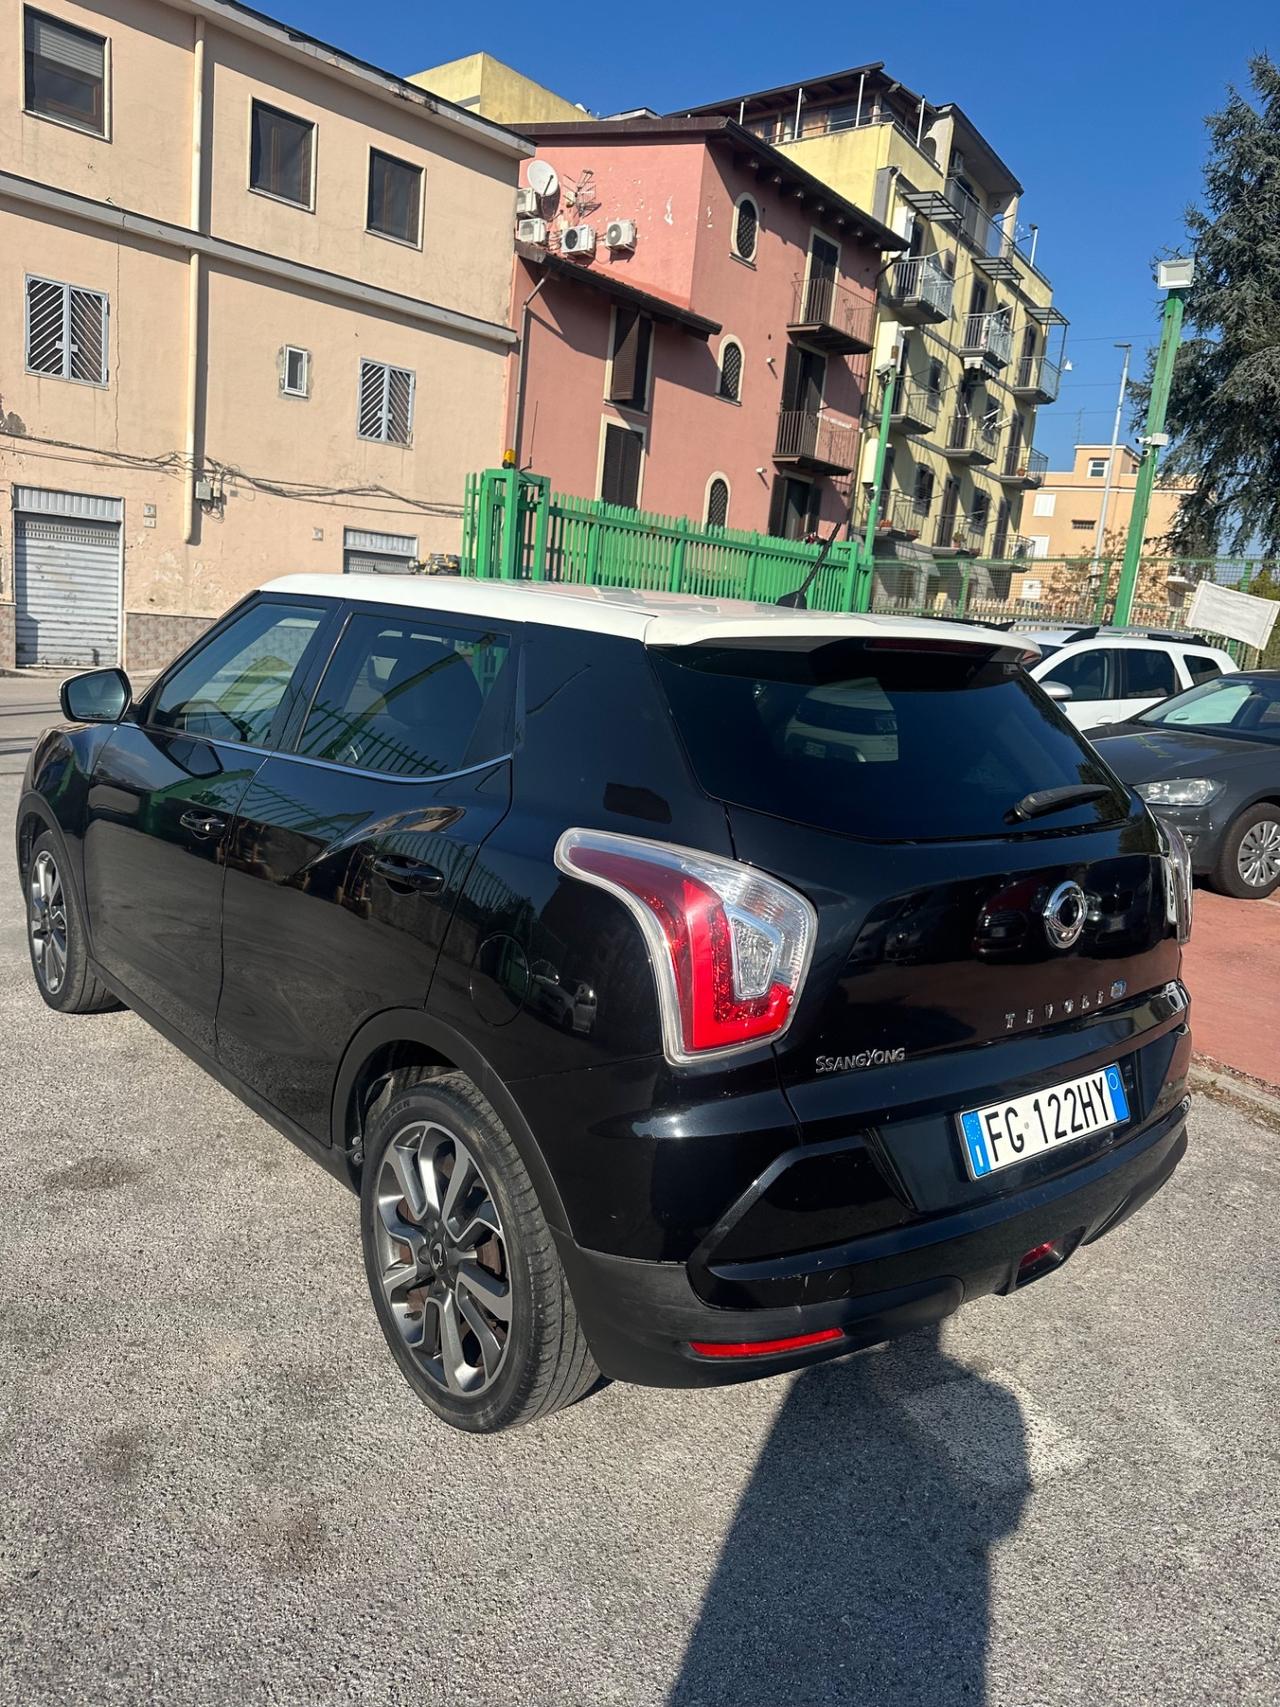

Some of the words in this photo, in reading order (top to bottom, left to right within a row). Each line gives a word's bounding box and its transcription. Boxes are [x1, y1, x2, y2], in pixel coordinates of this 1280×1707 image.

[815, 1047, 905, 1073] SSANGYONG
[984, 1106, 1025, 1163] FG
[1033, 1076, 1109, 1145] 122HY
